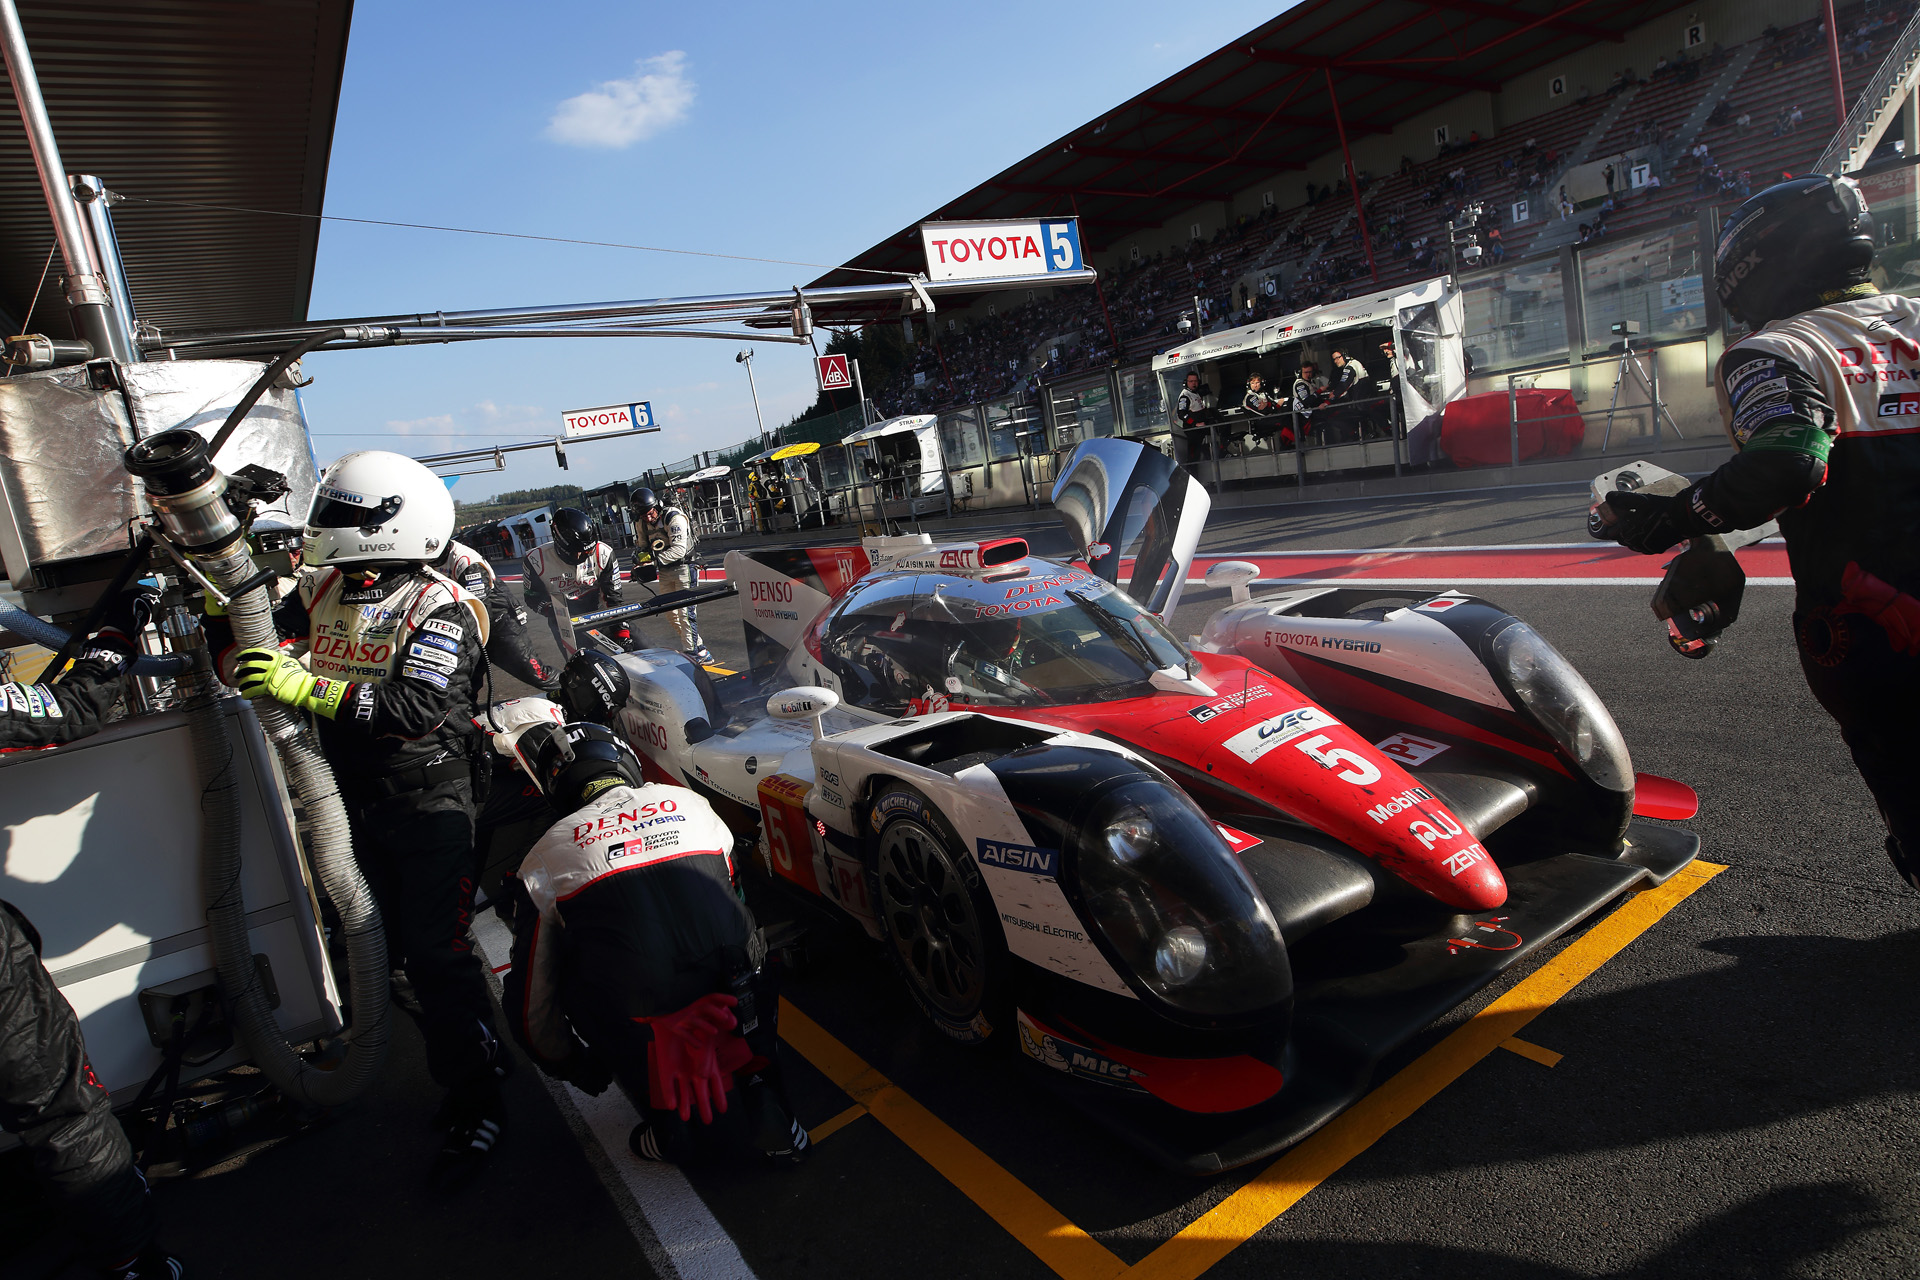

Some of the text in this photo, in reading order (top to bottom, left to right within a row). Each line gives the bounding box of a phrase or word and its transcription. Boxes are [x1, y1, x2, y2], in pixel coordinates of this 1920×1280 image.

[1689, 27, 1700, 44] R
[1552, 78, 1563, 94] Q
[1437, 128, 1446, 142] N
[1634, 166, 1647, 184] T
[1265, 194, 1271, 205] L
[1515, 202, 1527, 220] P
[931, 223, 1074, 269] TOYOTA 5
[1132, 248, 1138, 259] H
[1719, 250, 1763, 299] uvex
[1266, 281, 1275, 296] O
[1293, 325, 1320, 334] TOYOTA
[1320, 318, 1347, 328] GAZOO
[1347, 312, 1372, 322] Racing
[1180, 352, 1201, 360] TOYOTA
[1202, 347, 1222, 355] GAZOO
[1222, 342, 1242, 352] Racing
[828, 370, 842, 383] dB
[1734, 370, 1771, 402] AISIN
[1843, 370, 1911, 386] TOYOTA
[567, 404, 649, 429] TOYOTA 6
[1748, 406, 1790, 429] MICHELIN
[1879, 401, 1919, 416] GR
[1810, 441, 1825, 451] PIT
[358, 542, 396, 553] uvex
[939, 550, 974, 568] ZENT
[837, 558, 854, 583] HY
[905, 560, 924, 568] AISIN
[924, 560, 935, 568] AW
[750, 581, 793, 603] DENSO
[1003, 572, 1086, 600] DENSO
[590, 603, 641, 620] MICHELIN
[754, 608, 798, 621] TOYOTA HYBRID
[974, 596, 1063, 619] TOYOTA
[427, 619, 461, 636] JTEKT
[313, 635, 390, 664] DENSO
[423, 634, 456, 650] AISIN
[1264, 631, 1382, 654] 5 TOYOTA HYBRID
[313, 658, 387, 677] TOYOTA HYBRID
[591, 676, 616, 711] uvex
[1195, 684, 1266, 722] GR TOYOTA
[781, 701, 812, 714] Mobil 1
[627, 711, 668, 751] DENSO
[1258, 710, 1313, 740] WEC
[1294, 734, 1382, 786] 5
[1380, 737, 1438, 760] P1
[696, 769, 710, 784] GR
[710, 779, 737, 799] TOYOTA
[763, 774, 803, 798] DHL
[881, 795, 920, 814] MICHELIN
[1366, 786, 1435, 825] Mobil 1
[573, 799, 678, 844] DENSO
[577, 814, 686, 850] TOYOTA HYBRID
[608, 830, 680, 861] GR TOYOTA
[644, 835, 679, 846] GAZOO
[644, 840, 680, 852] Racing
[766, 804, 793, 871] 5
[982, 844, 1051, 871] AISIN
[1442, 843, 1488, 878] ZENT
[838, 868, 867, 908] P1
[452, 876, 474, 952] DENSO
[1001, 912, 1084, 942] MITSUBISHI ELECTRIC
